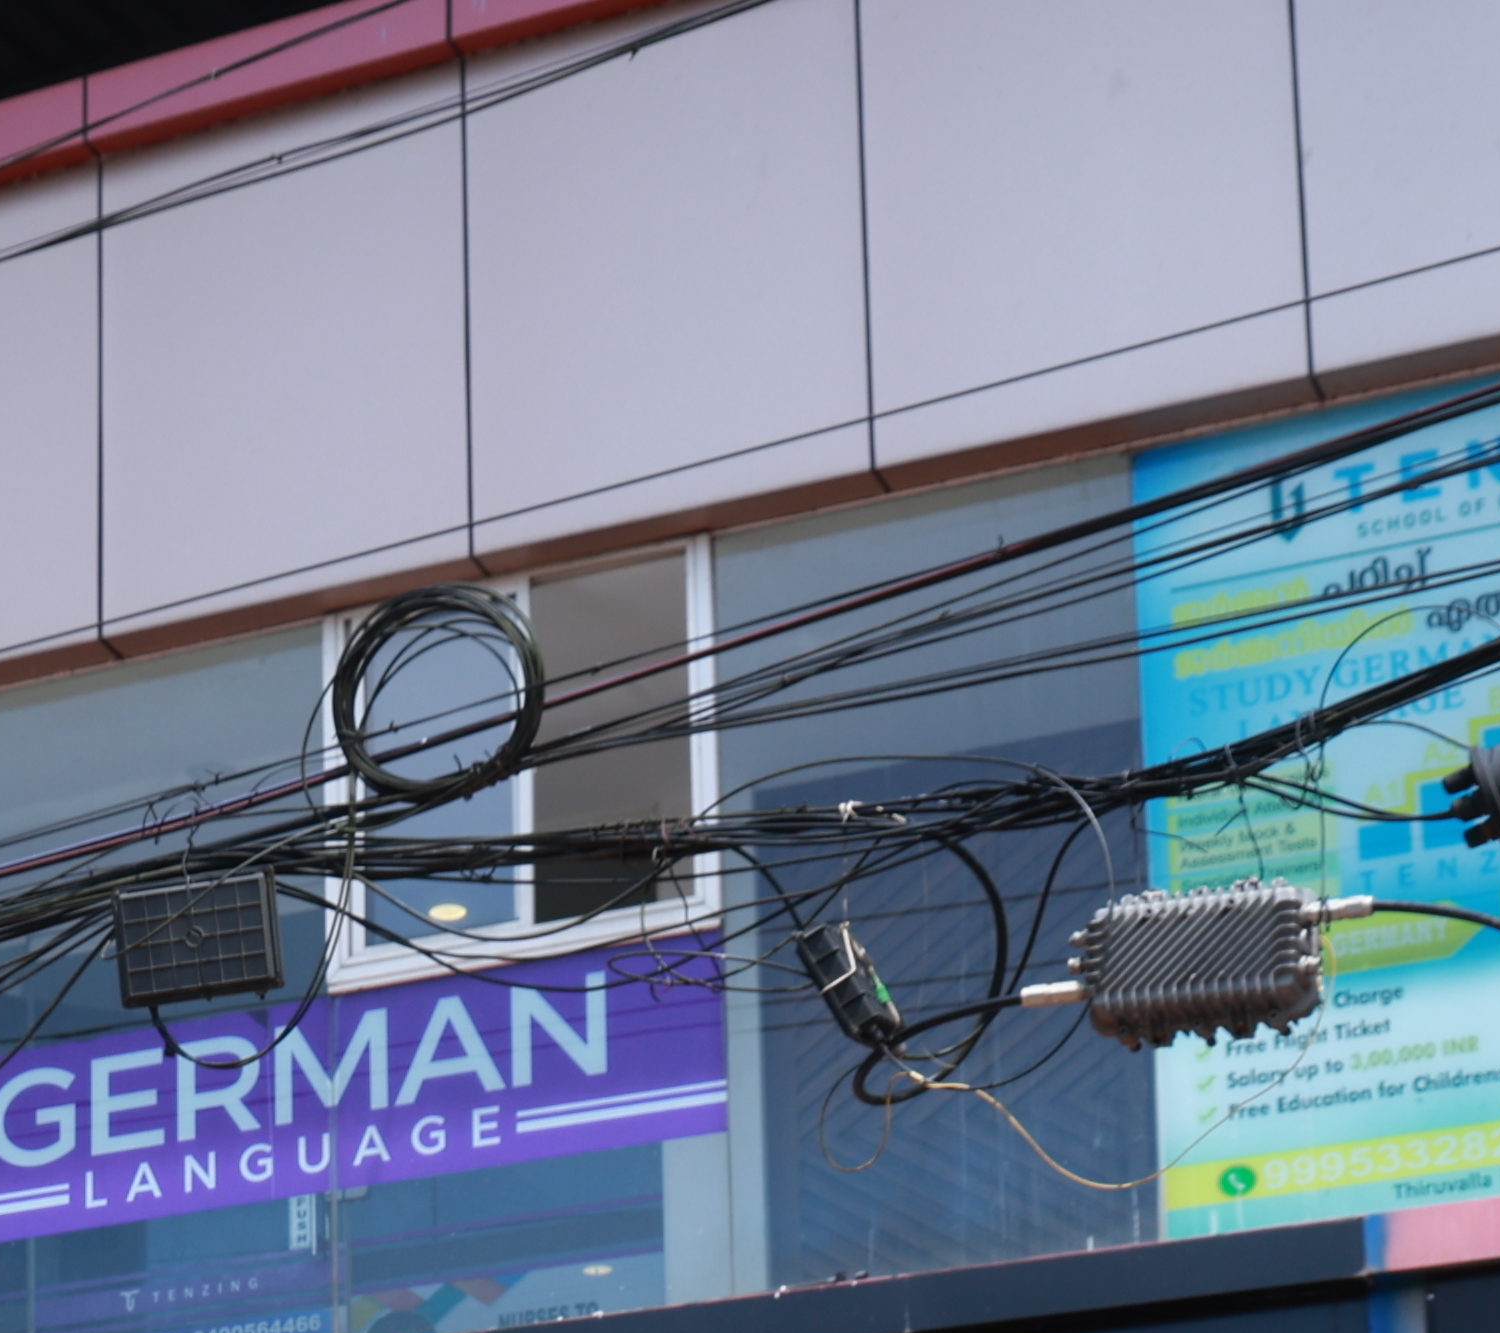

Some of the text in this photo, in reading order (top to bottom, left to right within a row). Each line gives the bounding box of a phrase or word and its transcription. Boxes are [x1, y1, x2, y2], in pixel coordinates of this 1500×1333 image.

[1357, 505, 1447, 539] SCHOOL
[1459, 496, 1488, 520] OF
[1188, 664, 1319, 716] STUDY
[1333, 985, 1406, 1011] Charge
[1224, 1017, 1392, 1058] Free Ticket
[1277, 1083, 1374, 1114] Education
[84, 1104, 502, 1209] LANGUAGE
[1394, 1171, 1494, 1200] Thiruvalla
